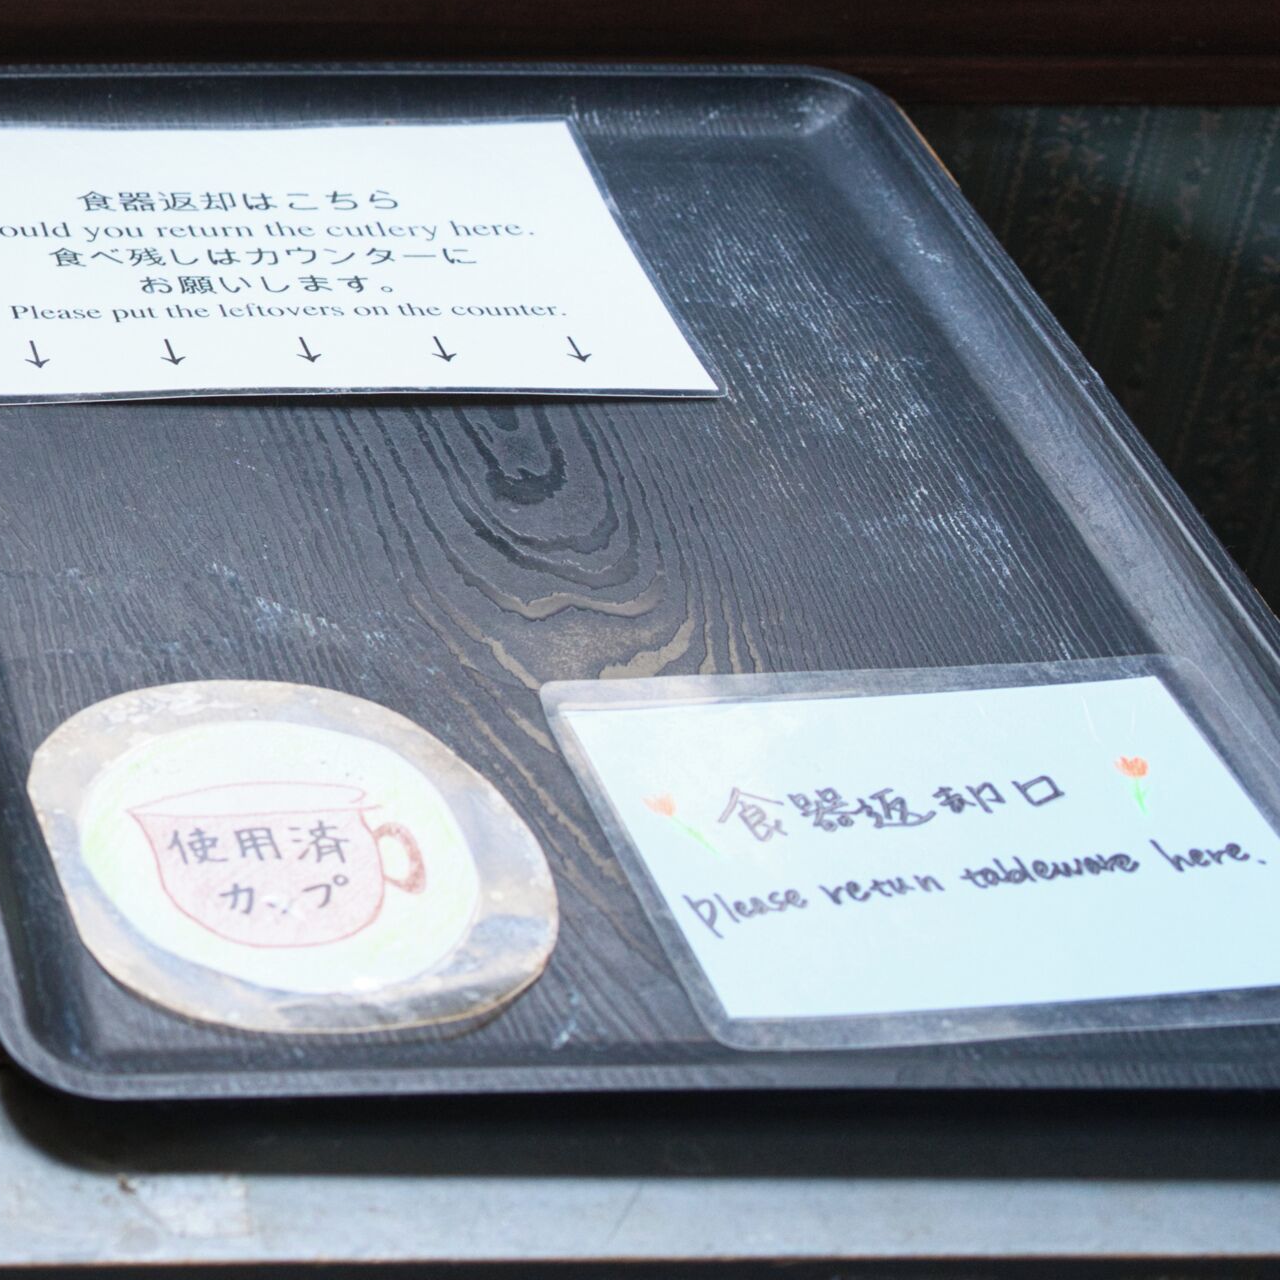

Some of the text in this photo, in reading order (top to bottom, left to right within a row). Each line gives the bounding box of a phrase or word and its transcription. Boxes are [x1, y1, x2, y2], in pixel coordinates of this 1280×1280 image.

[76, 189, 399, 212] 食器返却はこちら
[83, 225, 144, 243] you
[156, 221, 254, 238] return
[265, 221, 316, 238] the
[326, 221, 438, 242] cutlery
[450, 219, 536, 238] here.
[49, 246, 478, 268] 食べ残しはカウンターに
[139, 274, 394, 295] お願いします。
[9, 302, 568, 323] Please put the leftovers on the counter.
[717, 775, 1066, 843] 食器返却口
[167, 819, 351, 866] 使用済
[1149, 838, 1268, 873] here.
